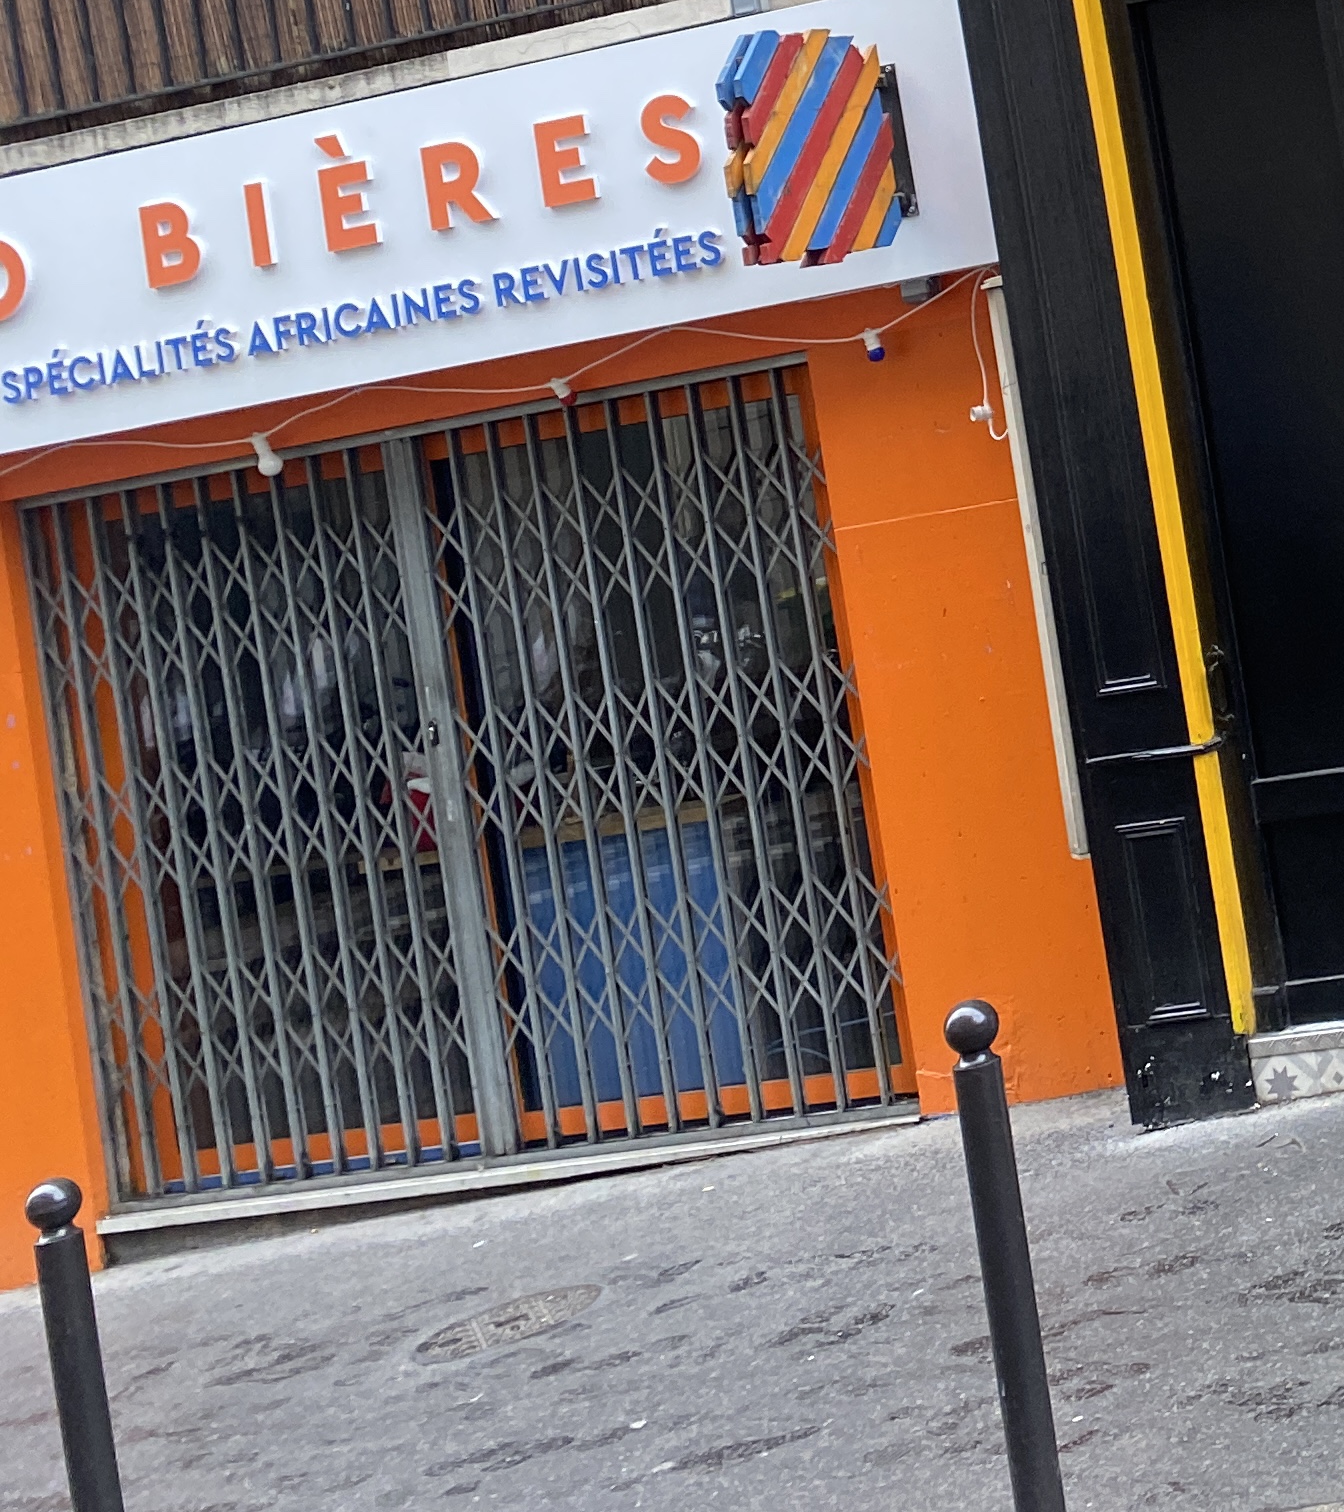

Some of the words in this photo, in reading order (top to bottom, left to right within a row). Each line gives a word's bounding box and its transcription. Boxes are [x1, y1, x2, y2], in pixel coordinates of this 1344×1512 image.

[138, 94, 701, 290] BIÈRES
[1, 318, 236, 405] SPÉCIALITÉS
[247, 278, 481, 357] AFRICAINES
[496, 226, 722, 308] REVISITÉES
